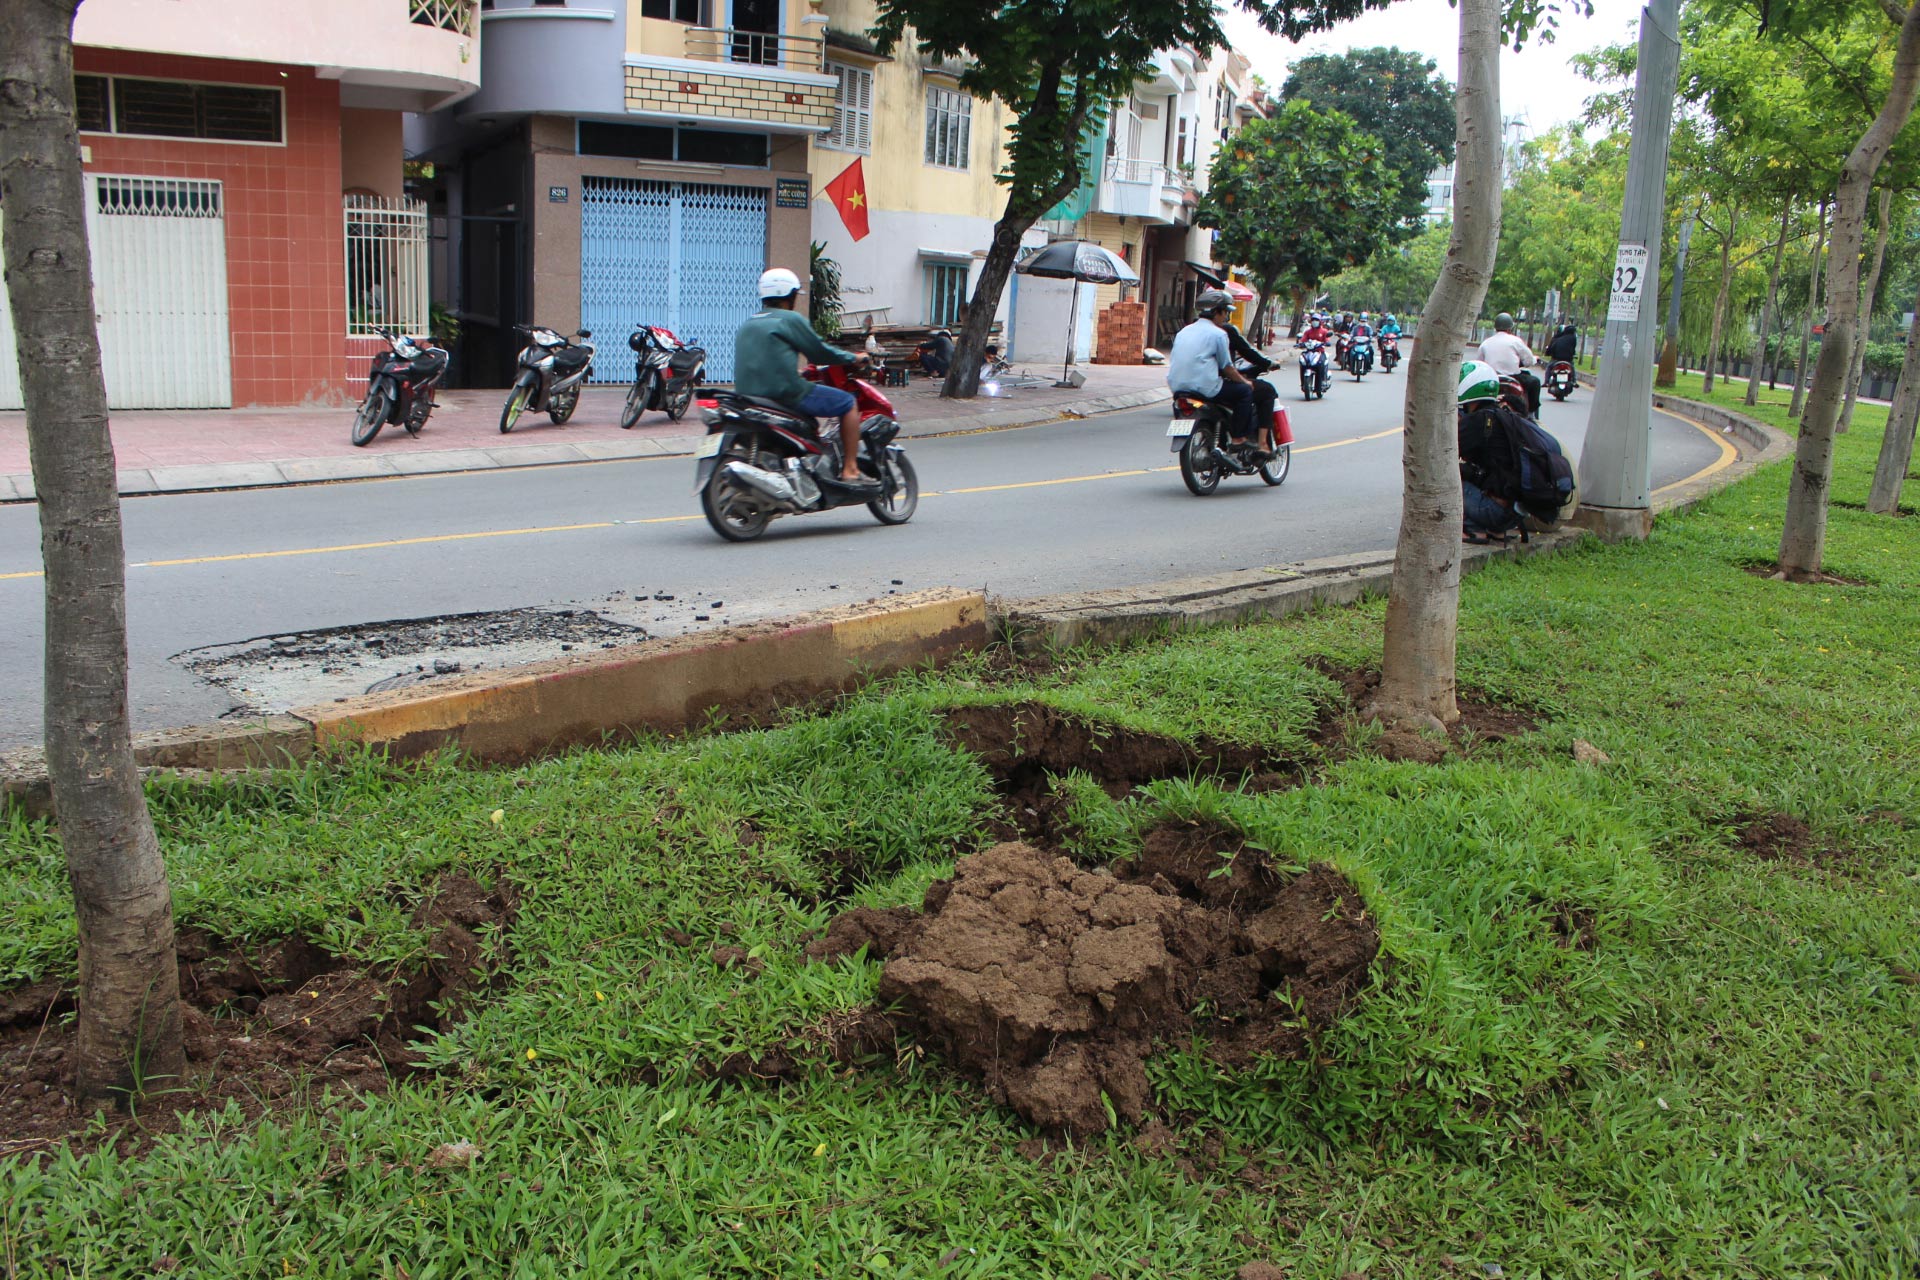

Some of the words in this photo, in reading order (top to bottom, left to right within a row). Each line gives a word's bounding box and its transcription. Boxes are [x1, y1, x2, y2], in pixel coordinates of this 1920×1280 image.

[1082, 258, 1106, 267] PHIN
[1083, 265, 1107, 274] DELI
[1612, 266, 1638, 293] 32
